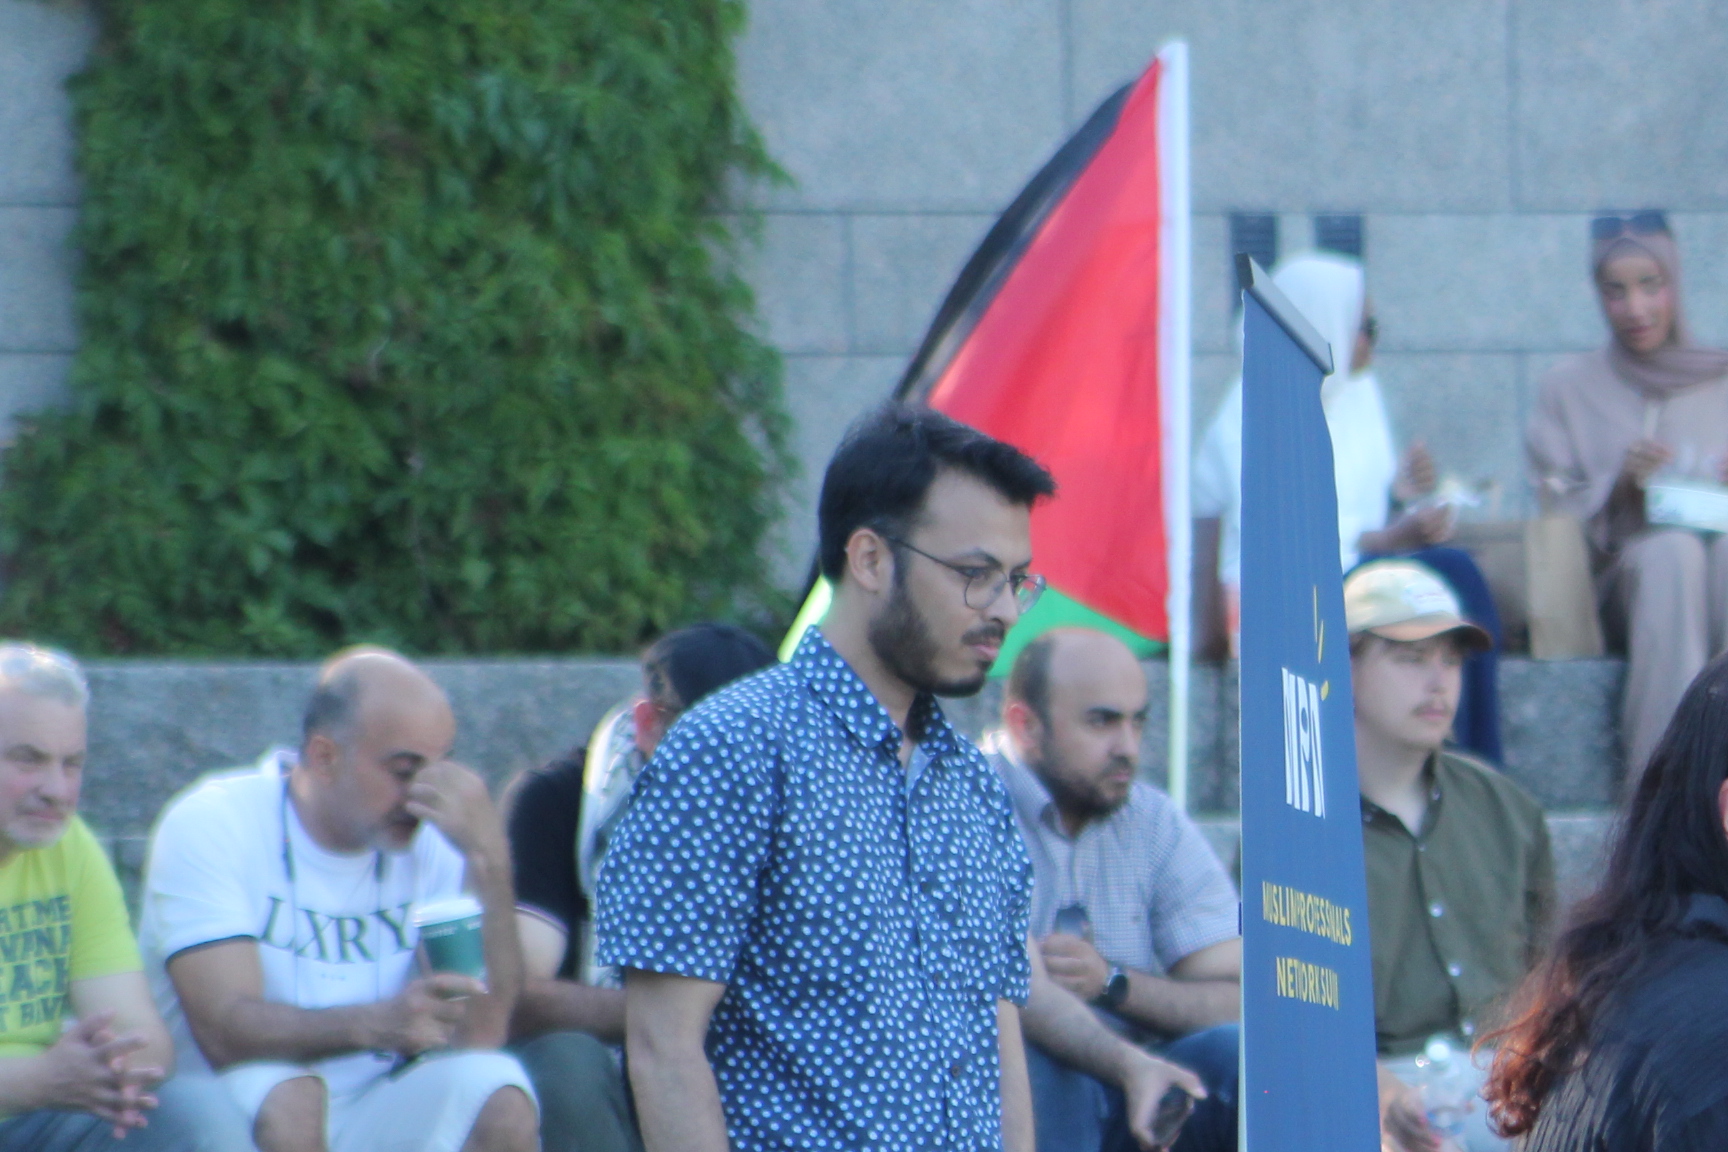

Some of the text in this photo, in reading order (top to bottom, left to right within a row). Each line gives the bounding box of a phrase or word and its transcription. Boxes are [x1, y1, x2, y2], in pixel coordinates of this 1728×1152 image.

[1281, 667, 1326, 820] MPN
[259, 896, 414, 965] LXRY
[1262, 880, 1296, 926] MSLIM
